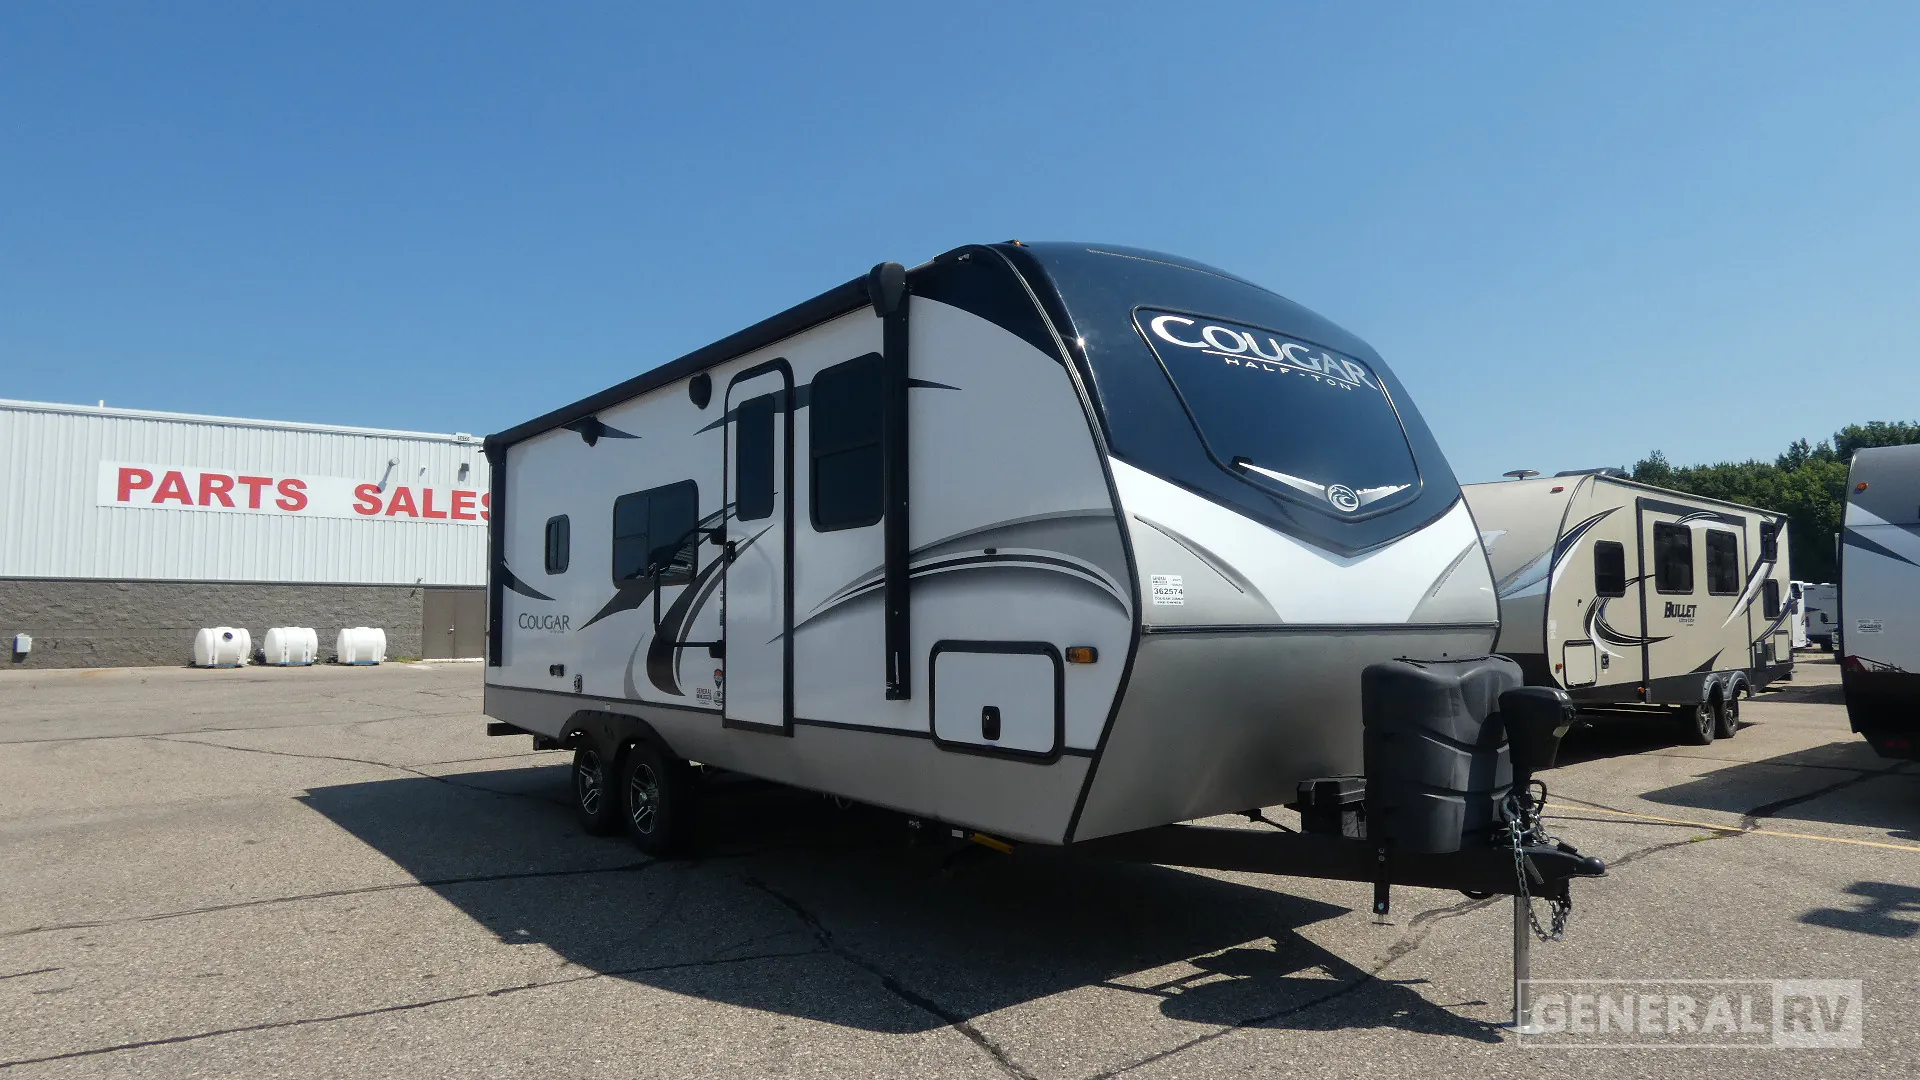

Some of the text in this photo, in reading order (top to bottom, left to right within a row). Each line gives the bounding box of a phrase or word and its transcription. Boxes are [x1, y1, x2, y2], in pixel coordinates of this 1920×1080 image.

[1150, 315, 1378, 390] COUGAR
[116, 467, 308, 511] PARTS
[518, 612, 571, 631] COUGAR
[1664, 601, 1697, 618] BULLET
